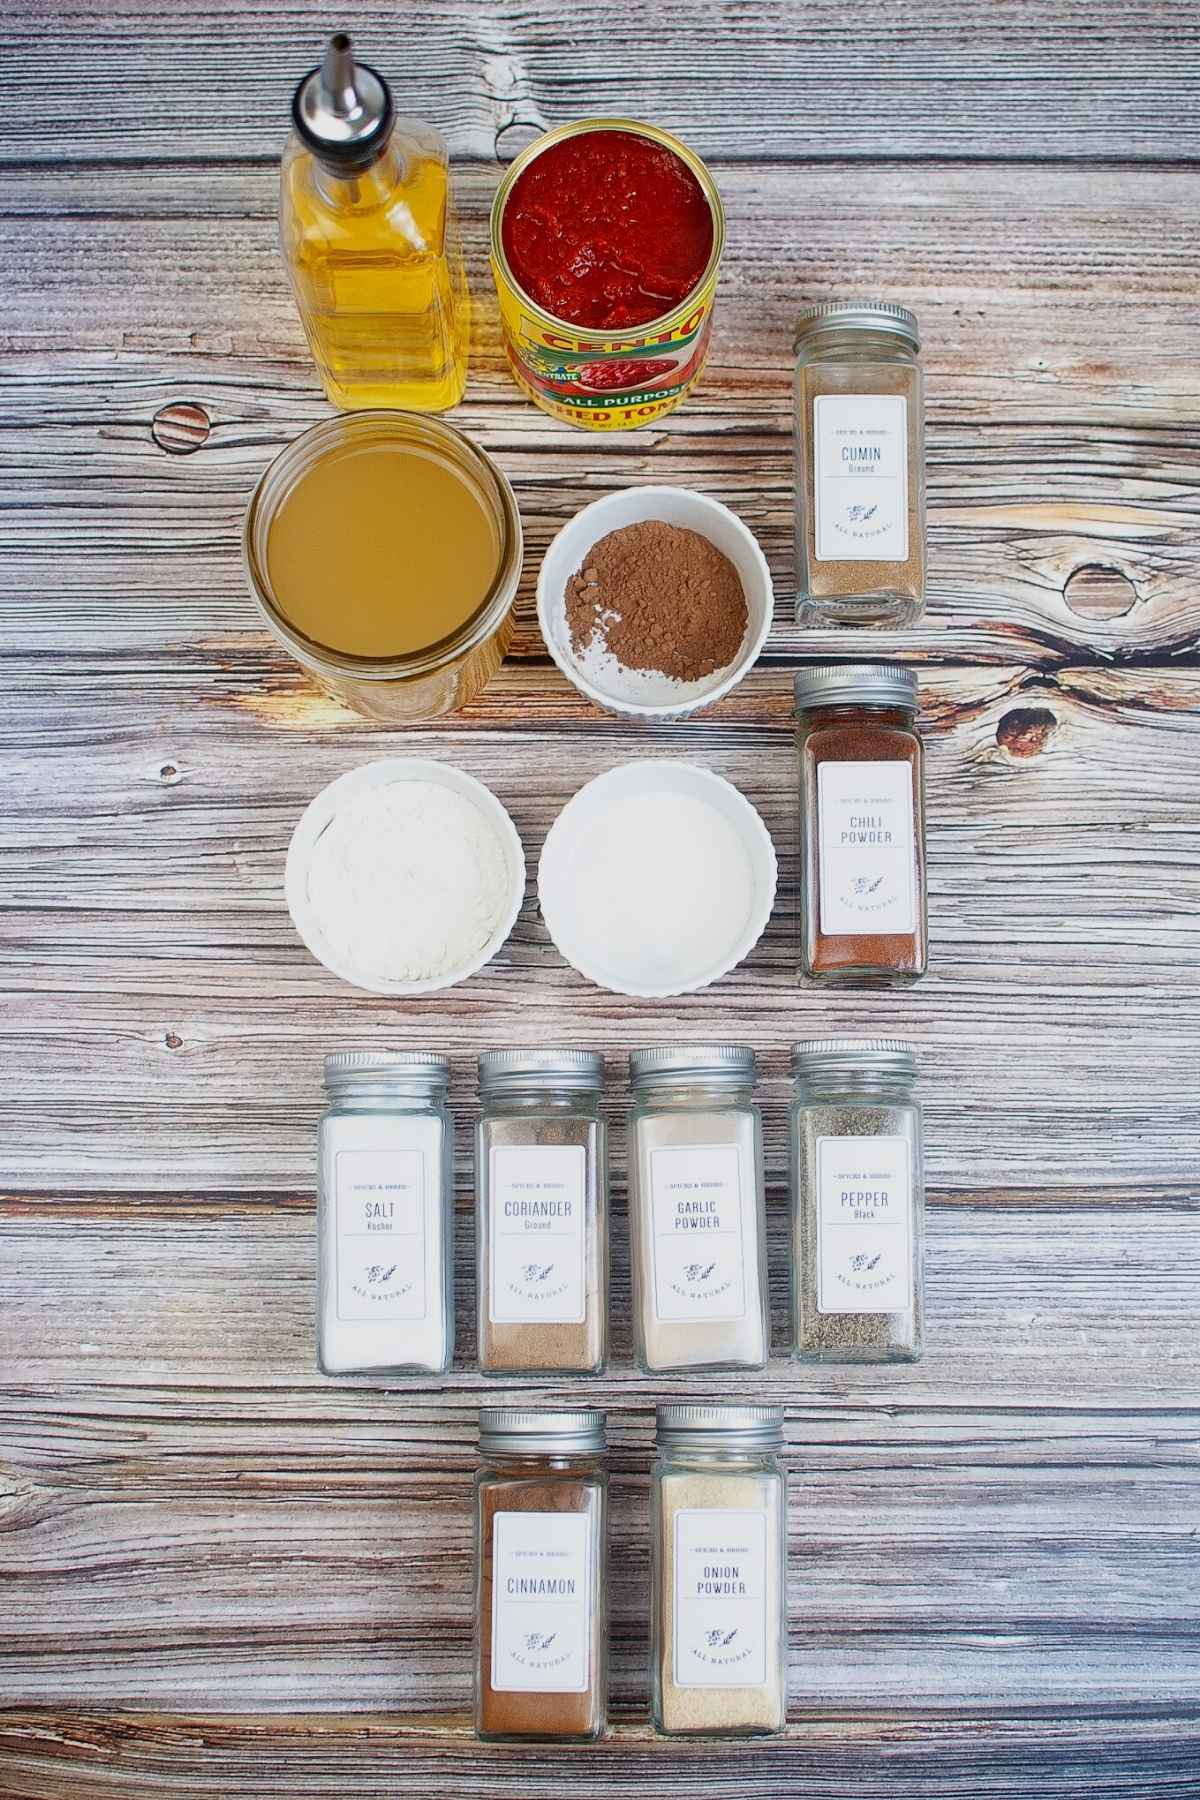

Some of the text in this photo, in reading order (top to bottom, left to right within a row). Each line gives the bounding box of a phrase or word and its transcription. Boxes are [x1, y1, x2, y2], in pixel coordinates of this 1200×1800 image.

[543, 307, 705, 352] CENTO
[563, 397, 599, 407] ALL
[842, 447, 881, 461] CUMIN
[850, 816, 882, 828] CHILI
[841, 832, 892, 844] POWDER
[841, 1192, 888, 1207] PEPPER
[365, 1202, 395, 1217] SALT
[504, 1201, 572, 1217] CORIANDER
[677, 1201, 716, 1214] GARLIC
[675, 1216, 720, 1229] POWDER
[703, 1566, 740, 1578] ONION
[507, 1577, 575, 1594] CINNAMON
[697, 1582, 746, 1594] POWDER
